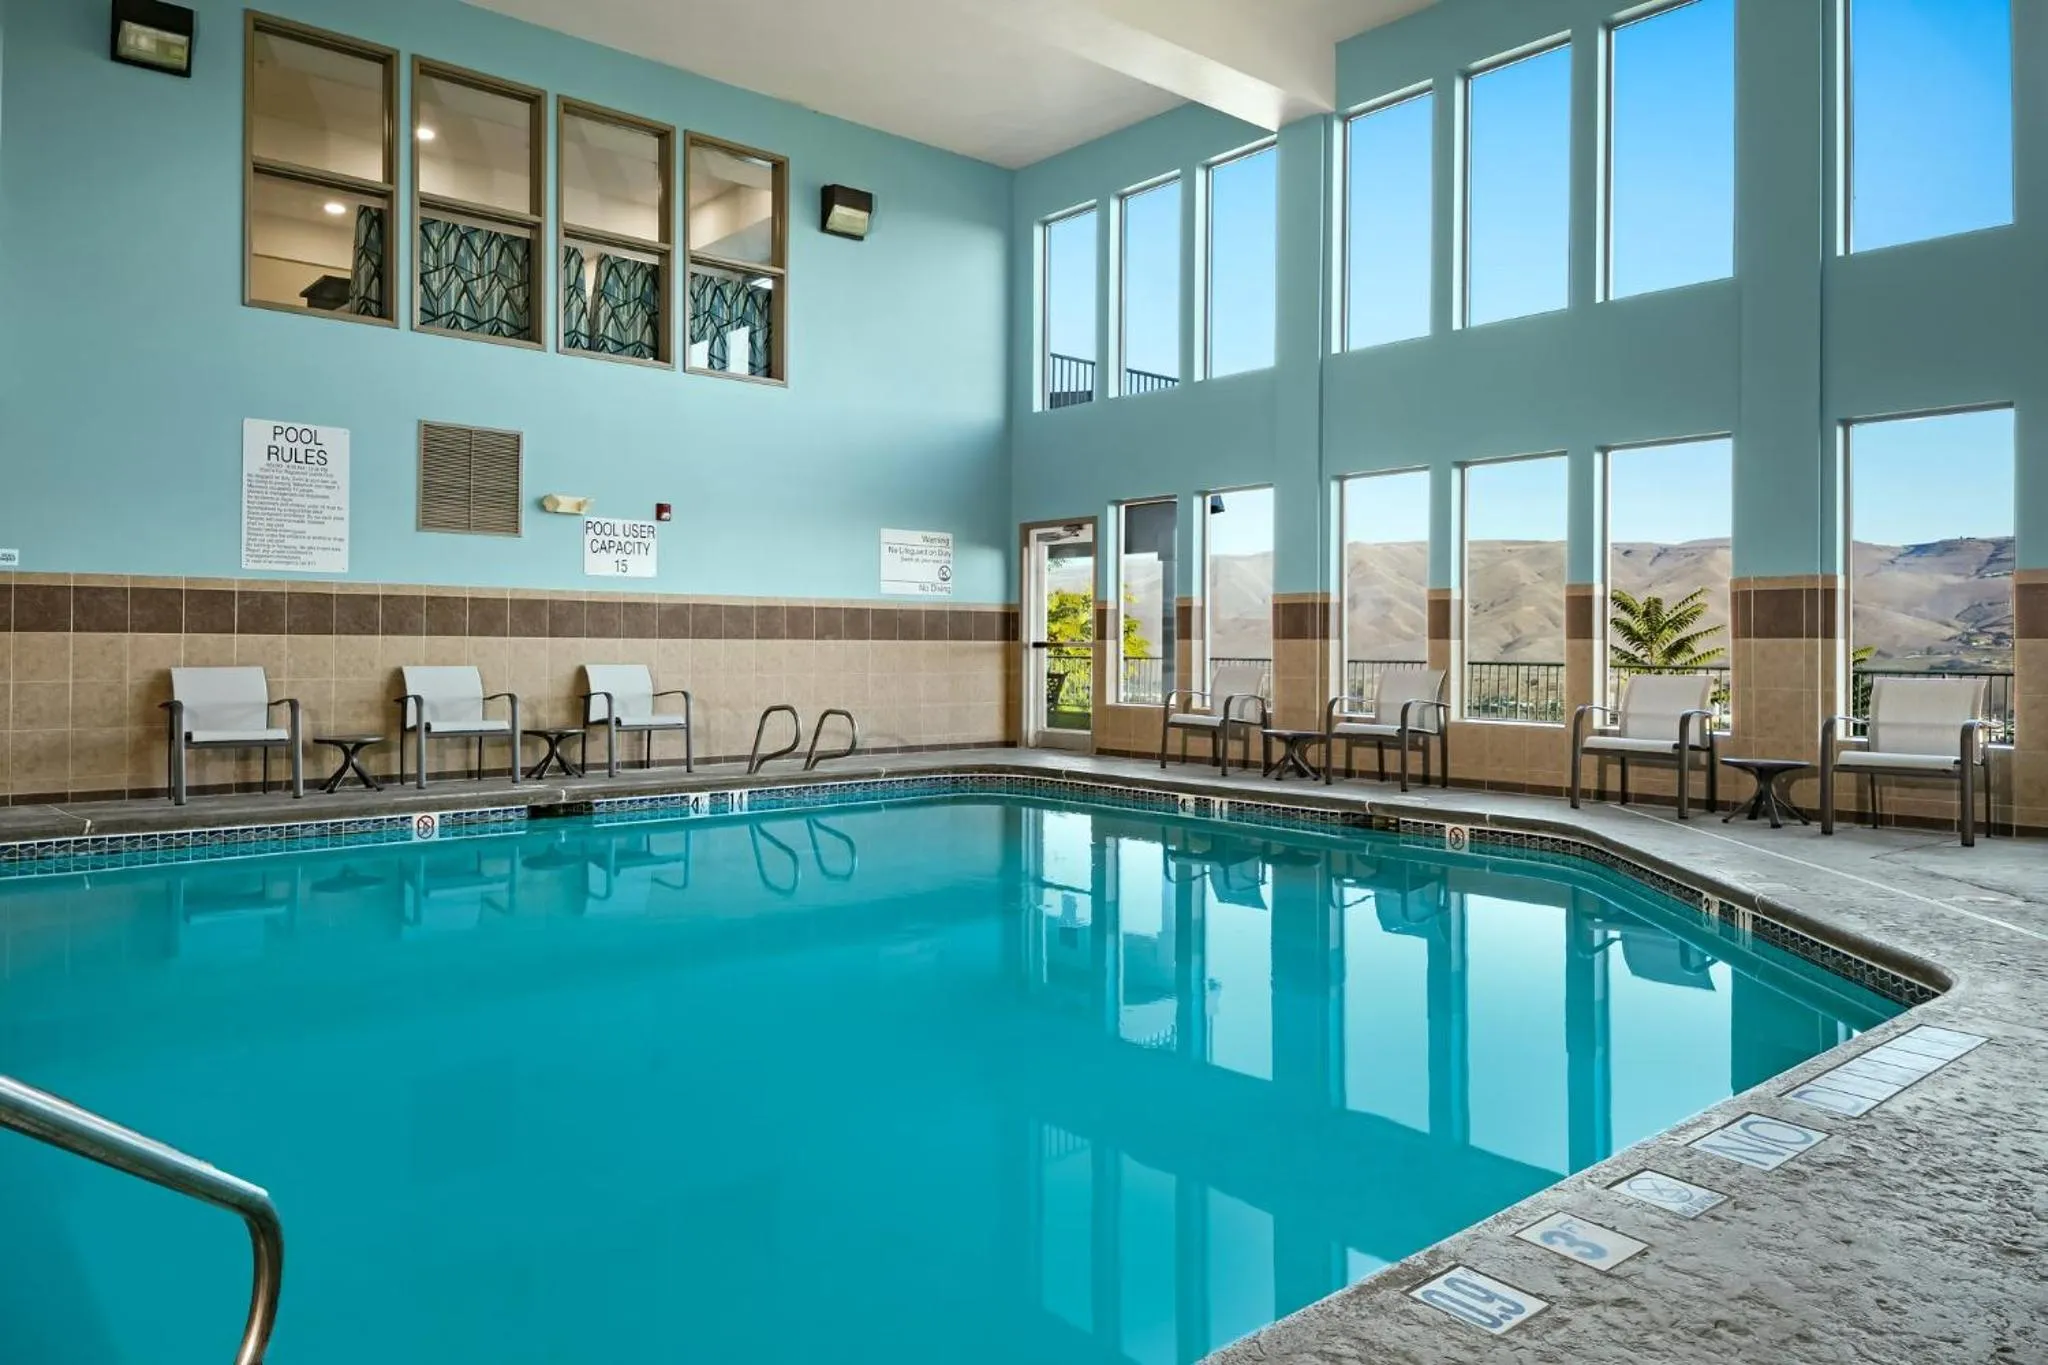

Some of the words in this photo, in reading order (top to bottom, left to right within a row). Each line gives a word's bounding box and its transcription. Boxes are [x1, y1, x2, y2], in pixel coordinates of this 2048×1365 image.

[273, 425, 323, 446] POOL
[267, 444, 328, 466] RULES
[585, 520, 619, 537] POOL
[623, 523, 655, 539] USER
[590, 538, 651, 556] CAPACITY
[614, 559, 628, 573] 15
[1700, 1120, 1814, 1166] NO
[1541, 1230, 1608, 1260] 3
[1421, 1276, 1526, 1329] 0.9
